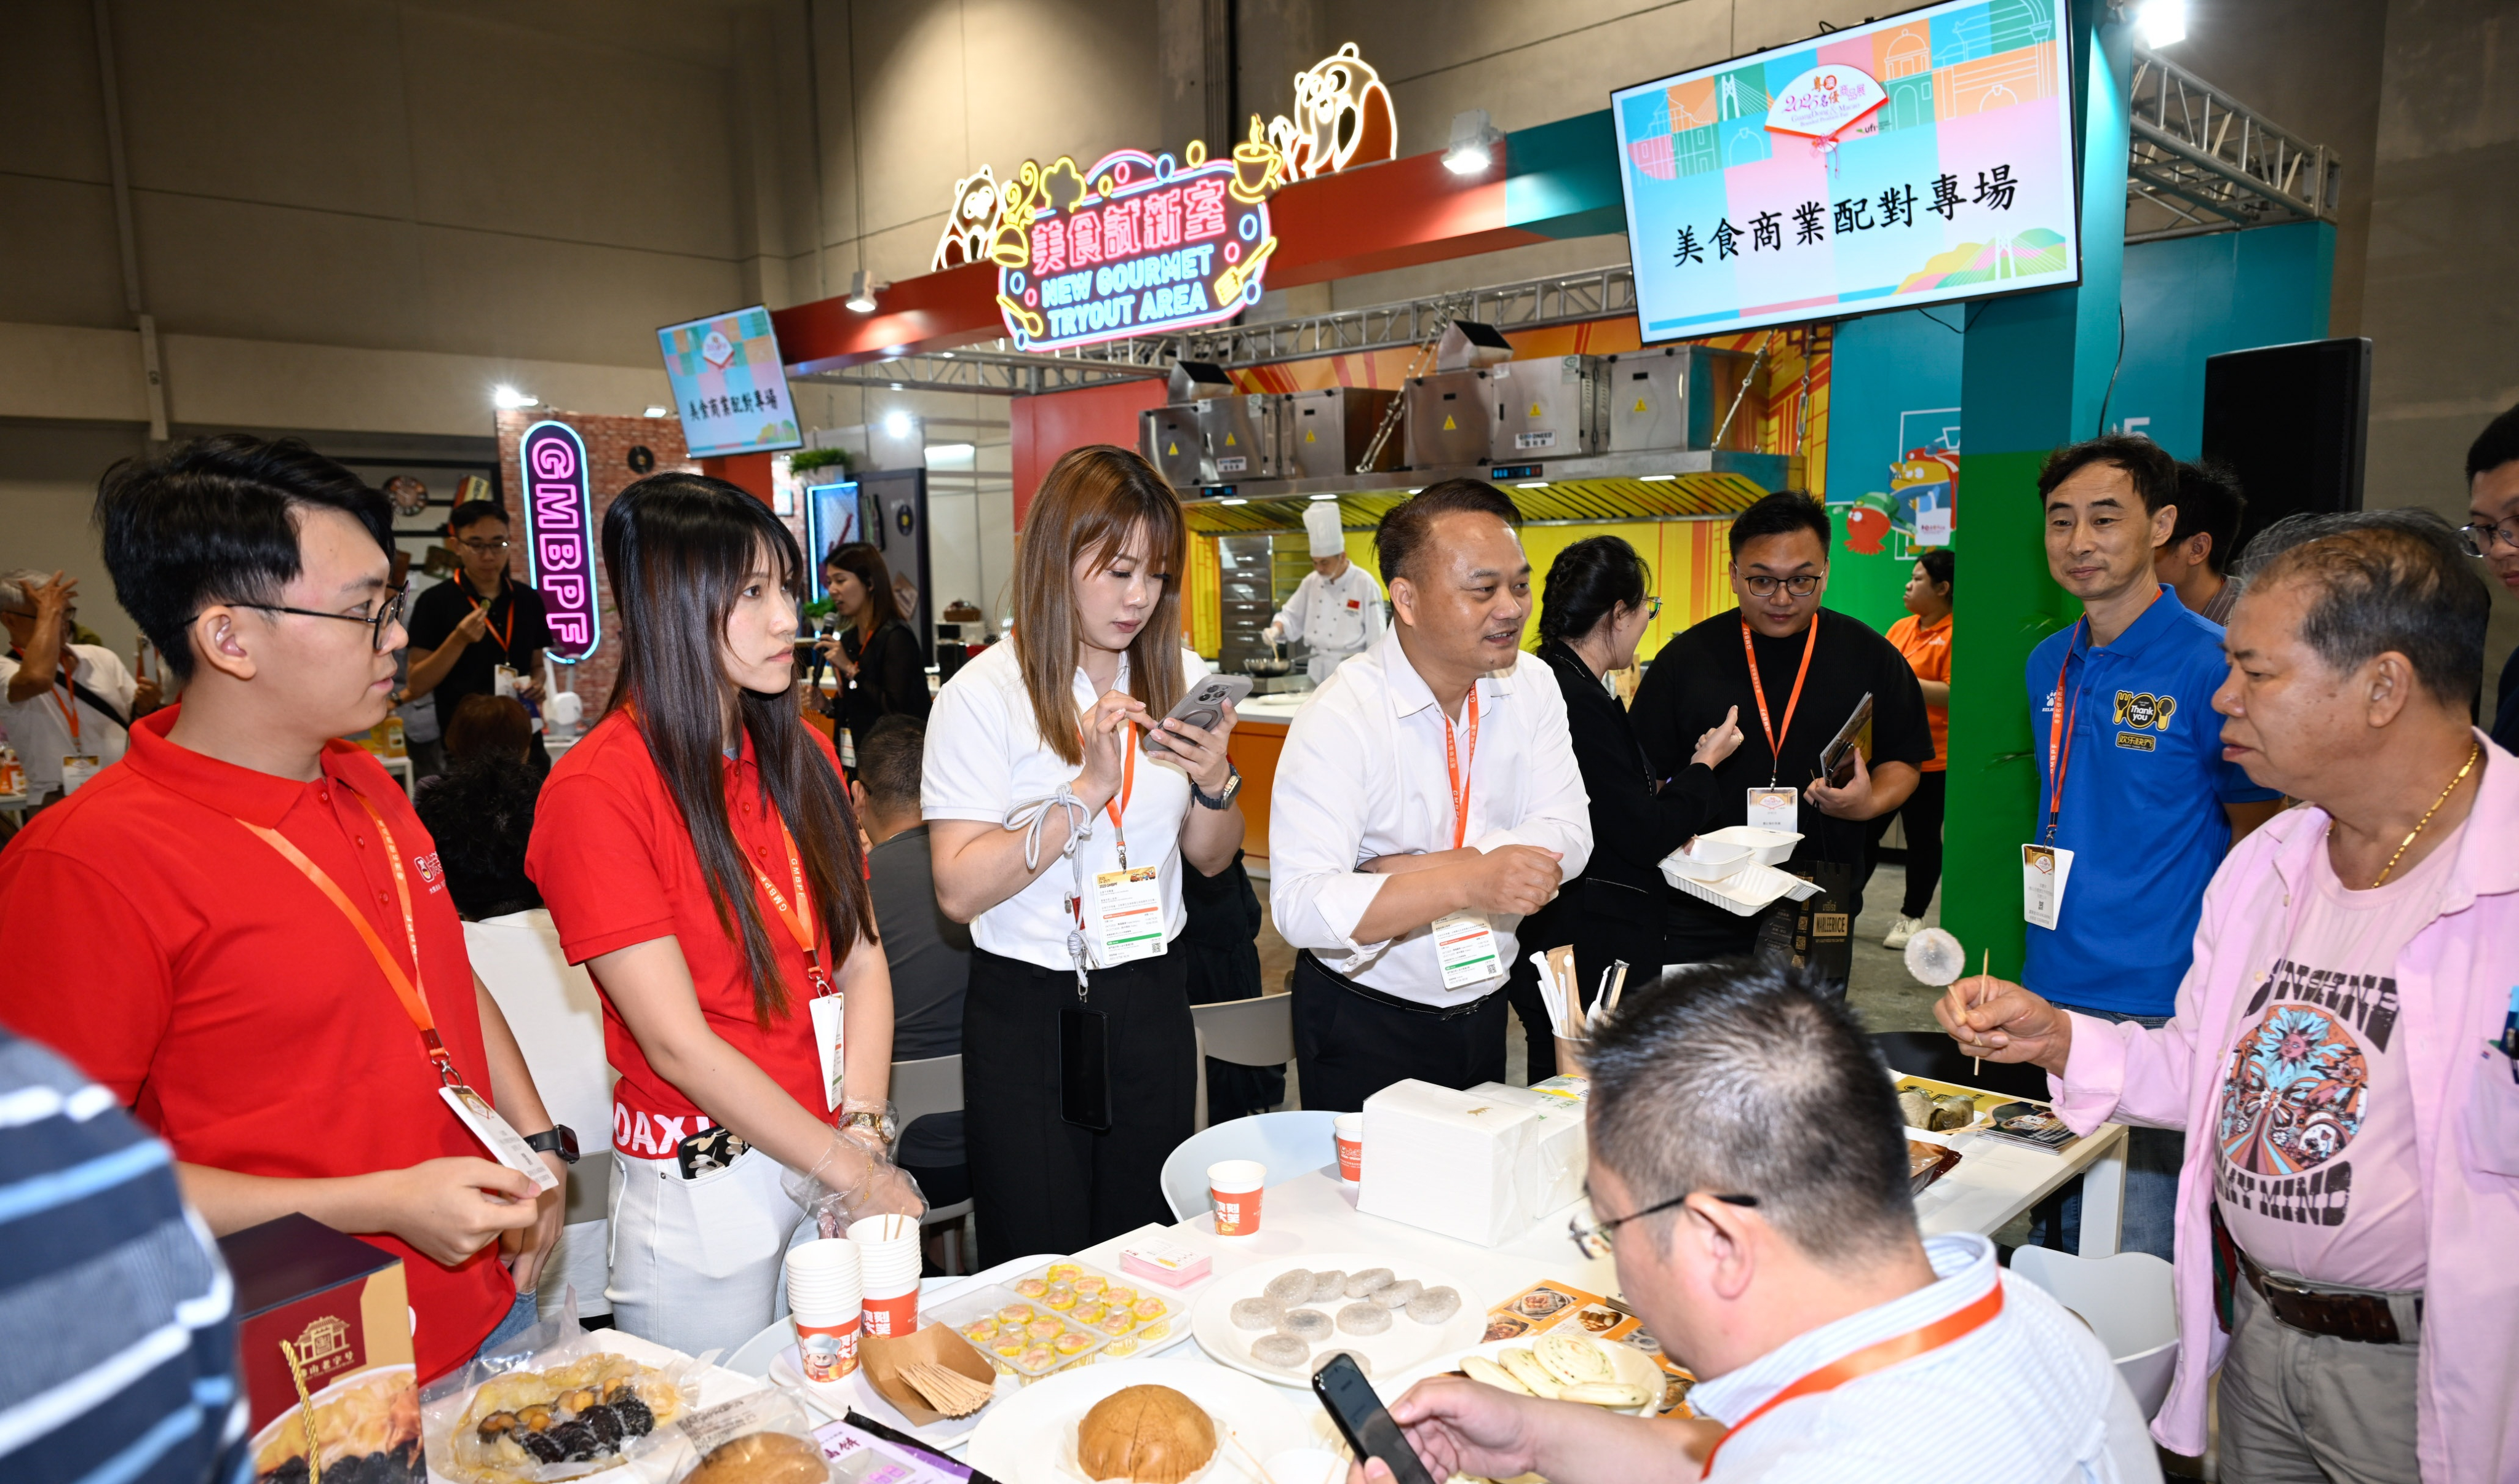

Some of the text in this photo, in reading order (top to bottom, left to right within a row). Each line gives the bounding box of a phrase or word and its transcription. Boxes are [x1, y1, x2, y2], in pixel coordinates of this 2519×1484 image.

[1030, 177, 1228, 277] 美食試新室
[1672, 163, 2020, 268] 美食商業配對專場
[1041, 244, 1216, 308] NEW GOURMET
[1047, 281, 1209, 339] TRYOUT AREA
[531, 437, 589, 645] GMBPF
[1743, 627, 1751, 650] GMBPF
[1760, 707, 1771, 732] GMBPF
[2130, 704, 2154, 716] Thank
[2132, 713, 2148, 721] you
[760, 876, 787, 911] GMBPF
[791, 858, 806, 898] GMBPF
[2259, 1160, 2352, 1227] MIND
[864, 1323, 891, 1335] 大笑
